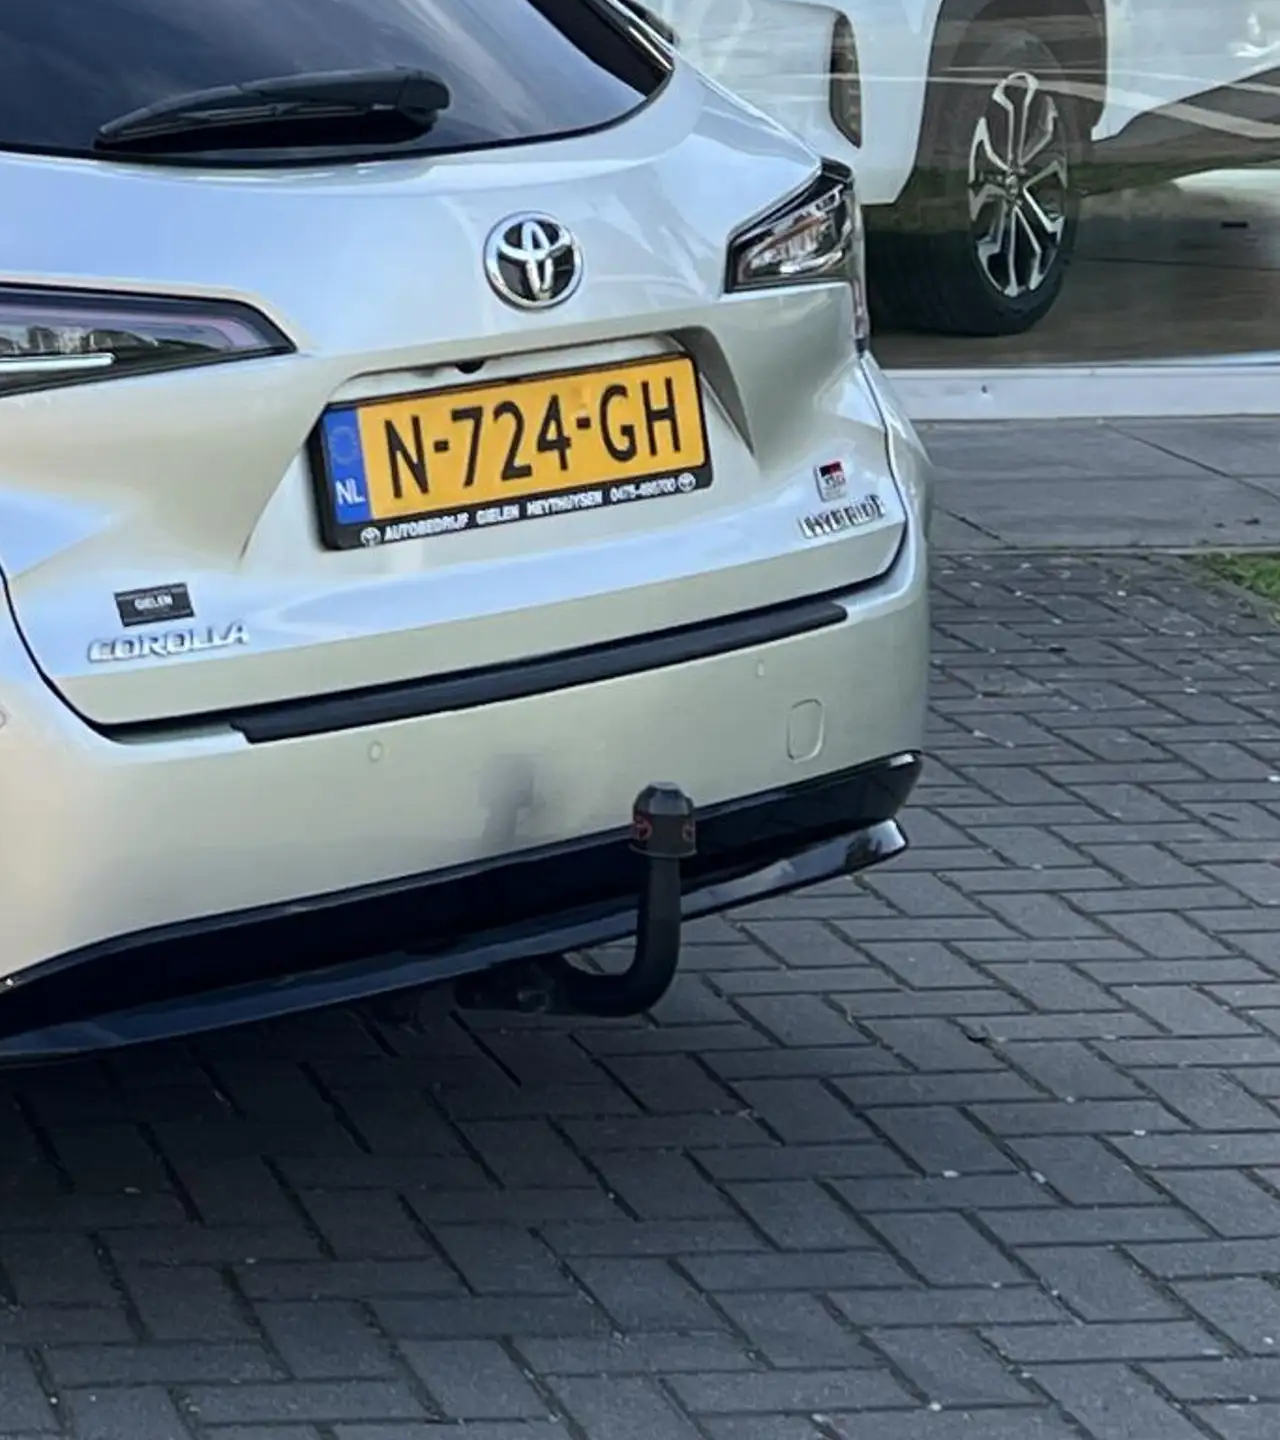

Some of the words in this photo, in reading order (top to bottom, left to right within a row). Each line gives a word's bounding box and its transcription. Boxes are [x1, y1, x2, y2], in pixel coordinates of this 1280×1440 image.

[383, 375, 682, 499] N-724-GH
[335, 477, 366, 505] NL
[87, 620, 251, 664] COROLLA
